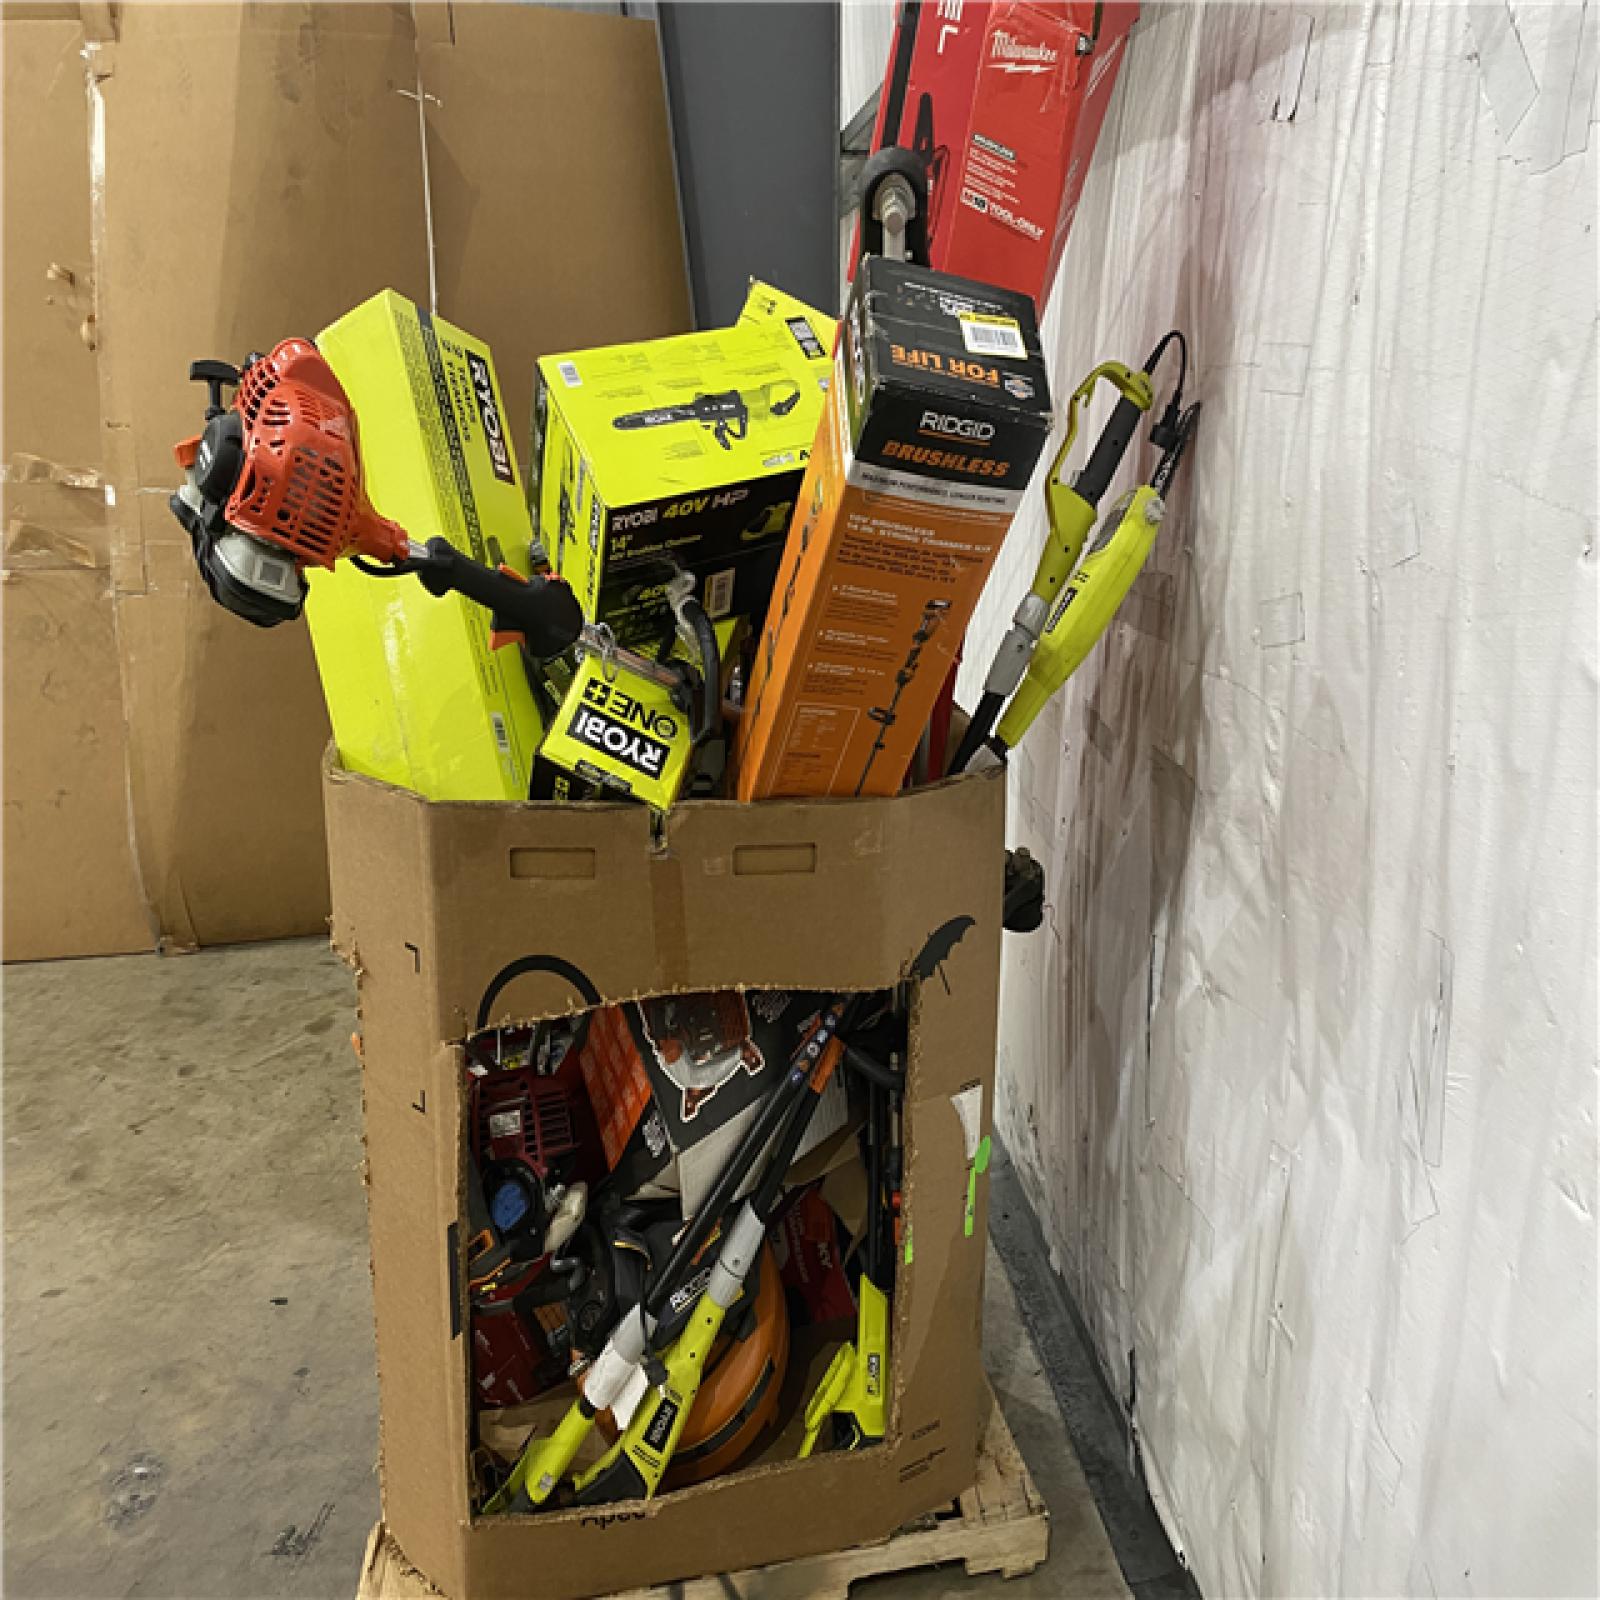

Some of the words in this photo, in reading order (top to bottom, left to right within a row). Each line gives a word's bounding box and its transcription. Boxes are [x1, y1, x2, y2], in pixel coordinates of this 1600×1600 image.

[889, 344, 943, 371] LIFE
[950, 358, 1000, 387] FOR
[469, 356, 512, 478] RYOBI
[920, 409, 996, 441] RIDGID
[881, 439, 1010, 477] BRUSHLESS
[612, 507, 658, 531] RYOBI
[662, 495, 710, 519] 40V
[710, 488, 750, 509] HP
[574, 710, 664, 772] RYOBI
